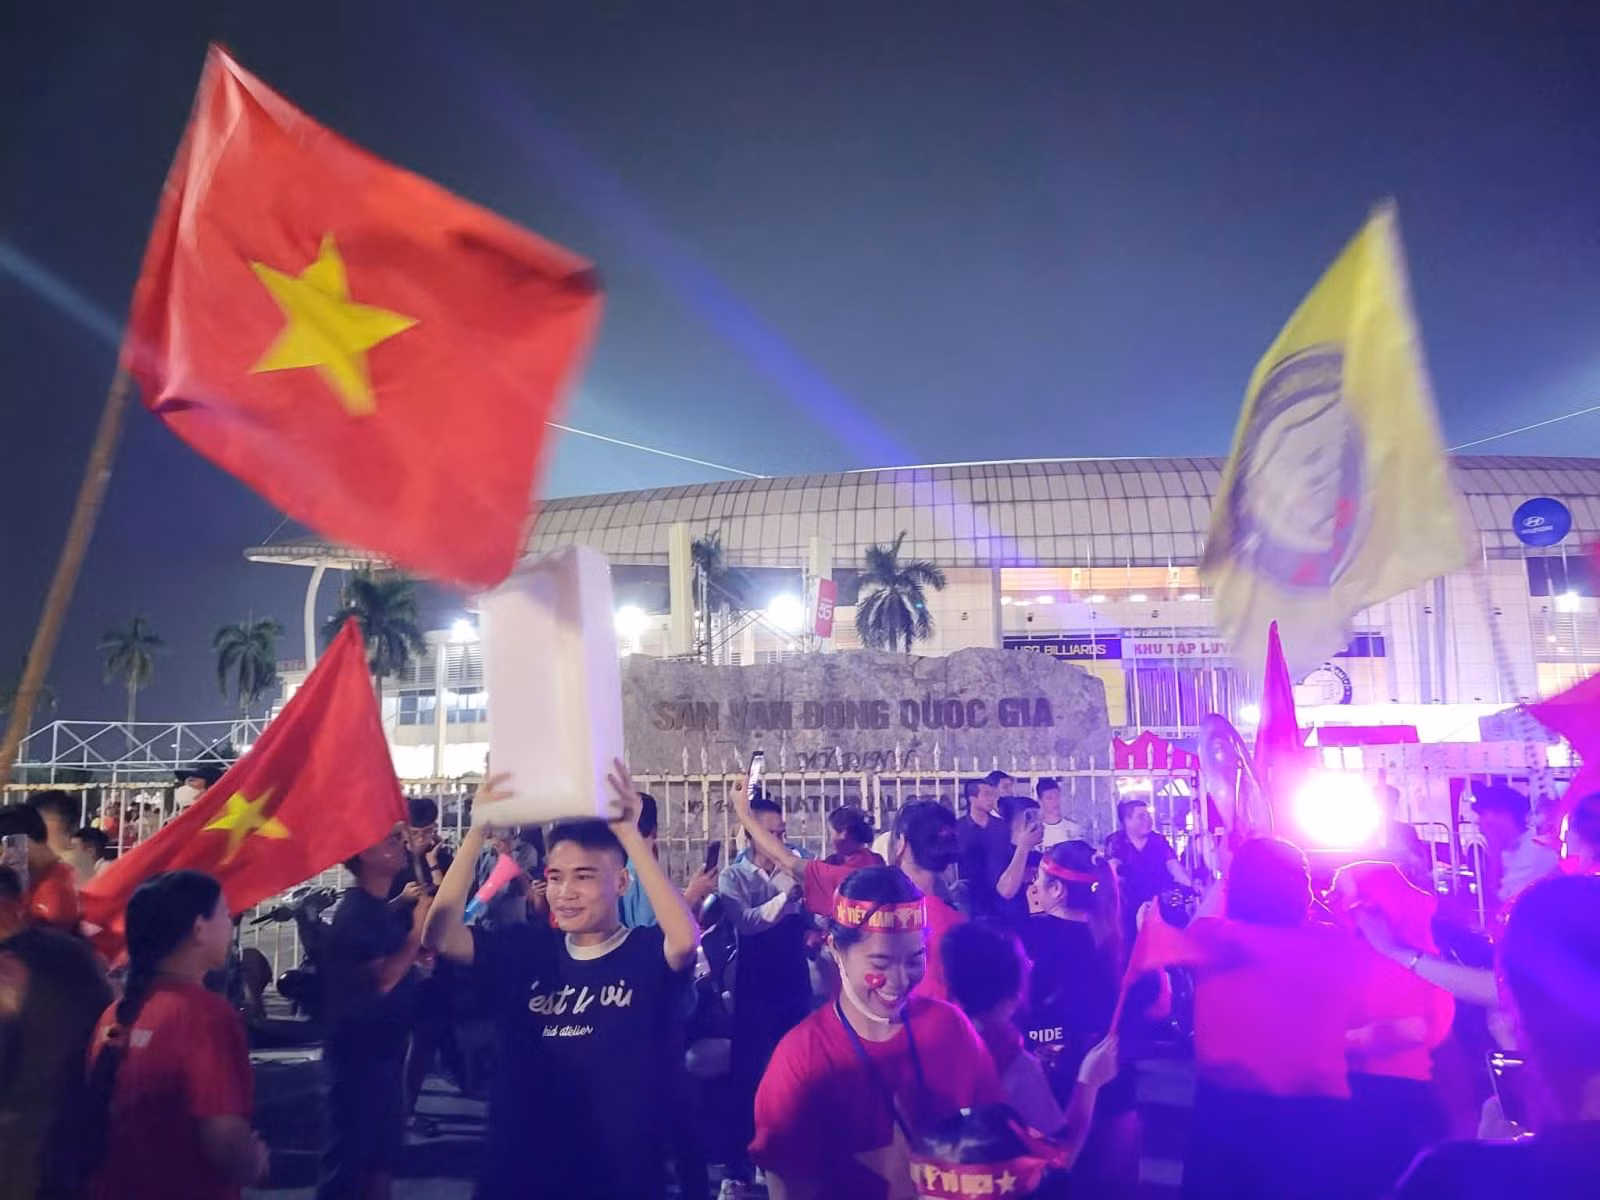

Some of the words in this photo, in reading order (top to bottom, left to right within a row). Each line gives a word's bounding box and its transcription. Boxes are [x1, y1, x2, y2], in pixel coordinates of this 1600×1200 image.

[1044, 644, 1107, 655] BILLIARDS
[1135, 643, 1163, 655] KHU
[653, 694, 720, 731] SÂN
[998, 698, 1055, 728] GIA
[559, 1024, 594, 1037] atelier
